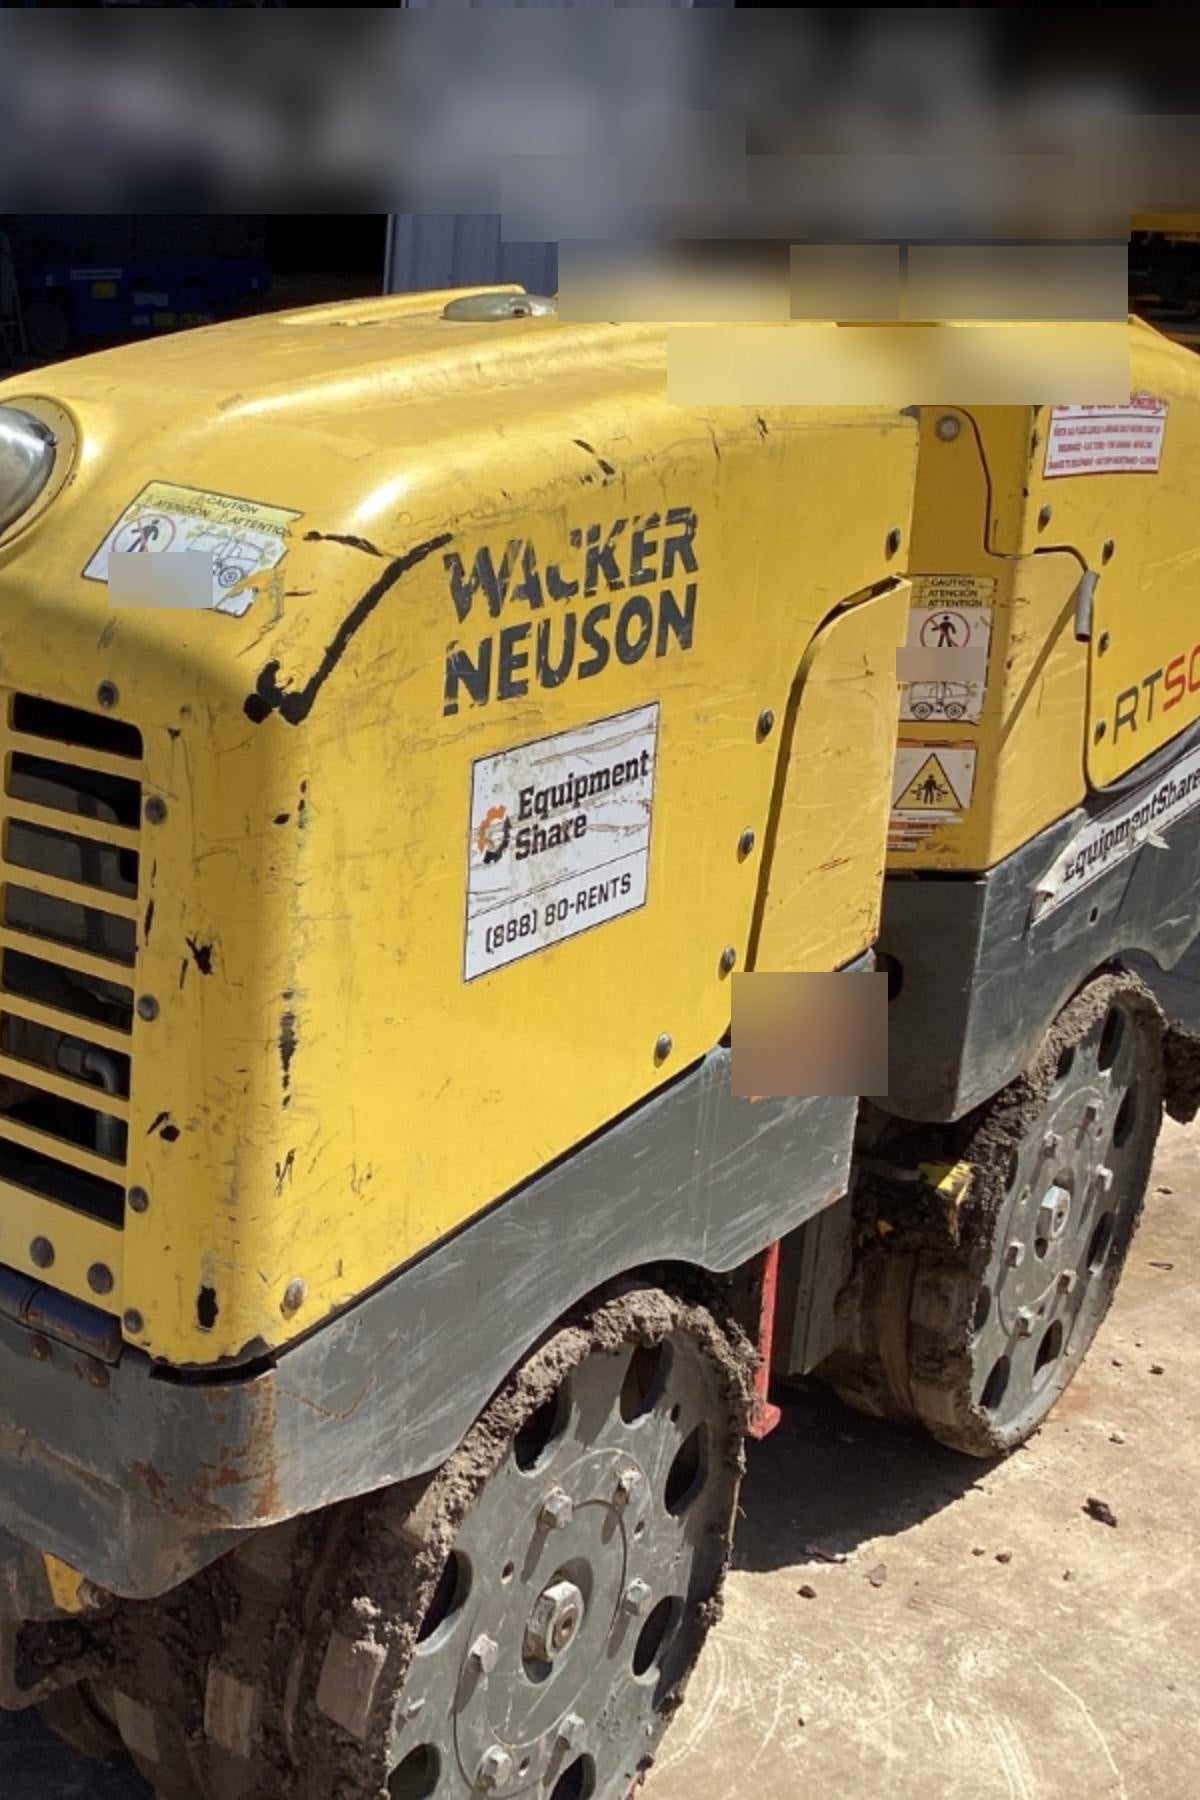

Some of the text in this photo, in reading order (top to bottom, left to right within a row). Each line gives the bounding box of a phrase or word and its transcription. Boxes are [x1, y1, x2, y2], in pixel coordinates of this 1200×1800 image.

[208, 496, 258, 514] CAUTION
[443, 583, 698, 717] NEUSON
[517, 749, 650, 822] Equipment
[514, 813, 587, 861] Share
[485, 909, 538, 954] (888)
